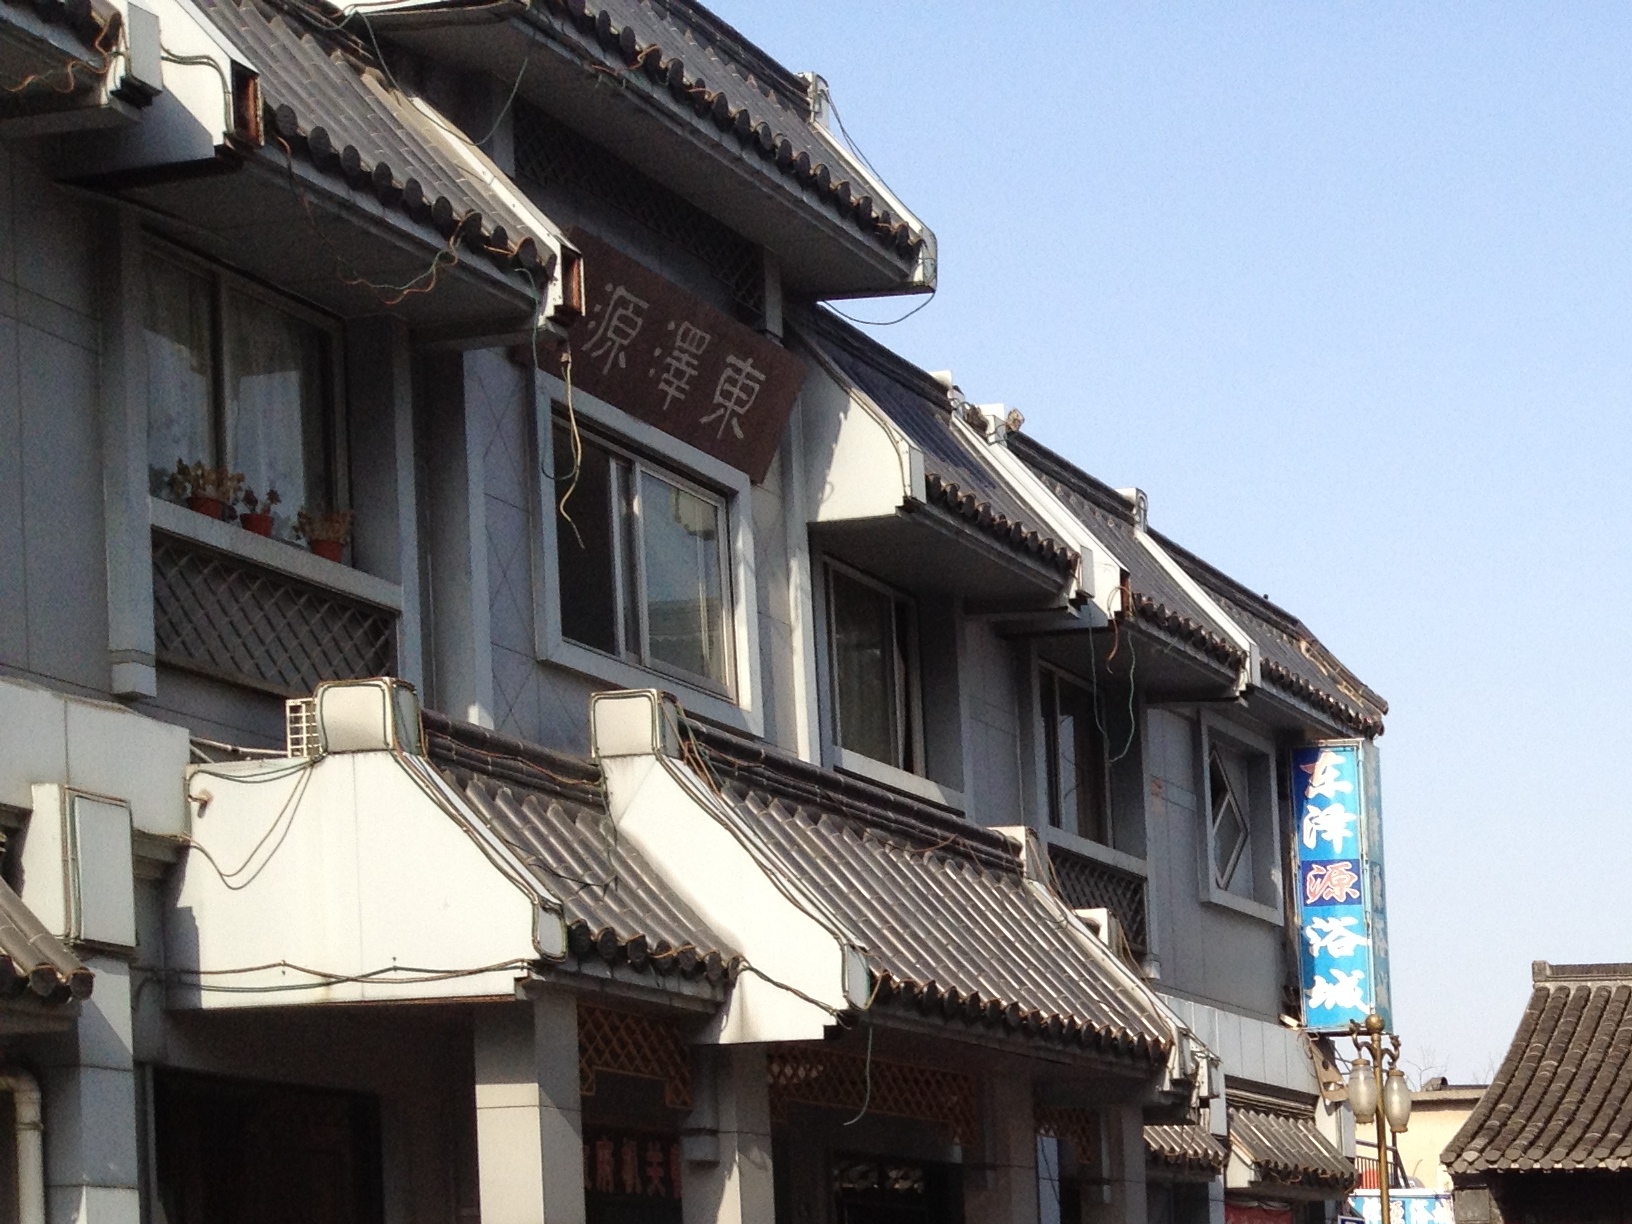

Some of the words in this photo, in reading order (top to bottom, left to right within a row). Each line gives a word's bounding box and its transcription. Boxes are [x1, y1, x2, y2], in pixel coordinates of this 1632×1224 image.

[1299, 750, 1372, 1016] 东泽源浴城
